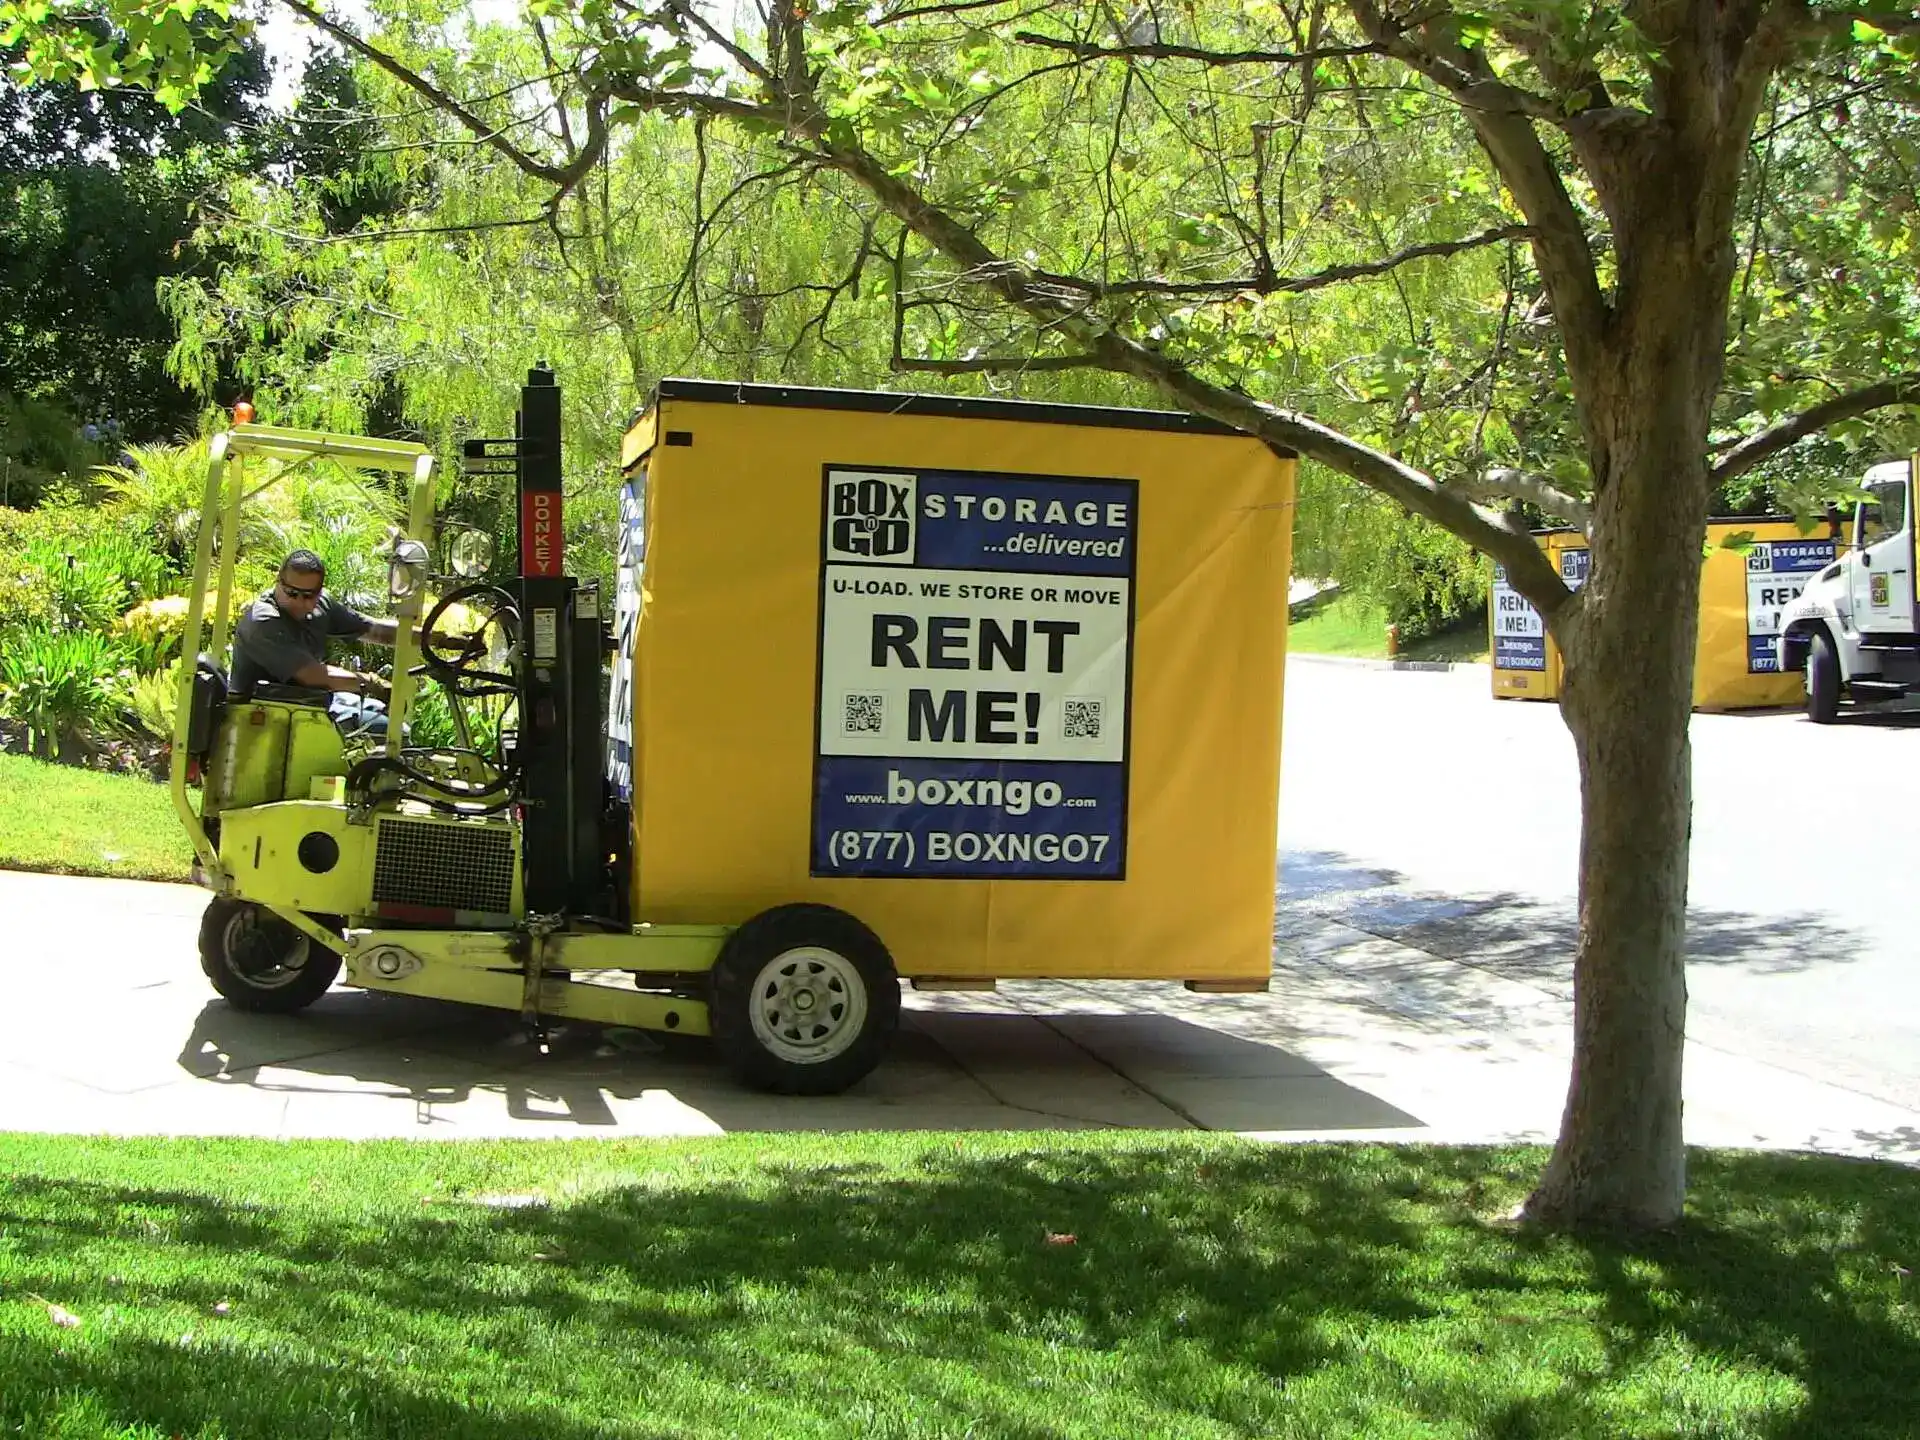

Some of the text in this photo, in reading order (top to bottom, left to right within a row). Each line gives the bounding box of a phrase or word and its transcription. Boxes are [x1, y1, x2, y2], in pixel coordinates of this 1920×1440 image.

[834, 479, 910, 519] BOX
[924, 494, 1128, 528] STORAGE
[534, 495, 551, 573] DONKEY
[833, 518, 910, 556] GO
[983, 533, 1125, 558] ...delivered
[1773, 546, 1833, 557] STORAGE
[832, 579, 1121, 605] U-LOAD. WE STORE OR MOVE
[1761, 587, 1805, 606] REN
[1505, 616, 1527, 632] ME!
[871, 613, 1080, 673] RENT
[907, 688, 1041, 745] ME!
[845, 769, 1097, 815] www.boxngo.com
[829, 831, 1110, 868] (877) BOXNGO7
